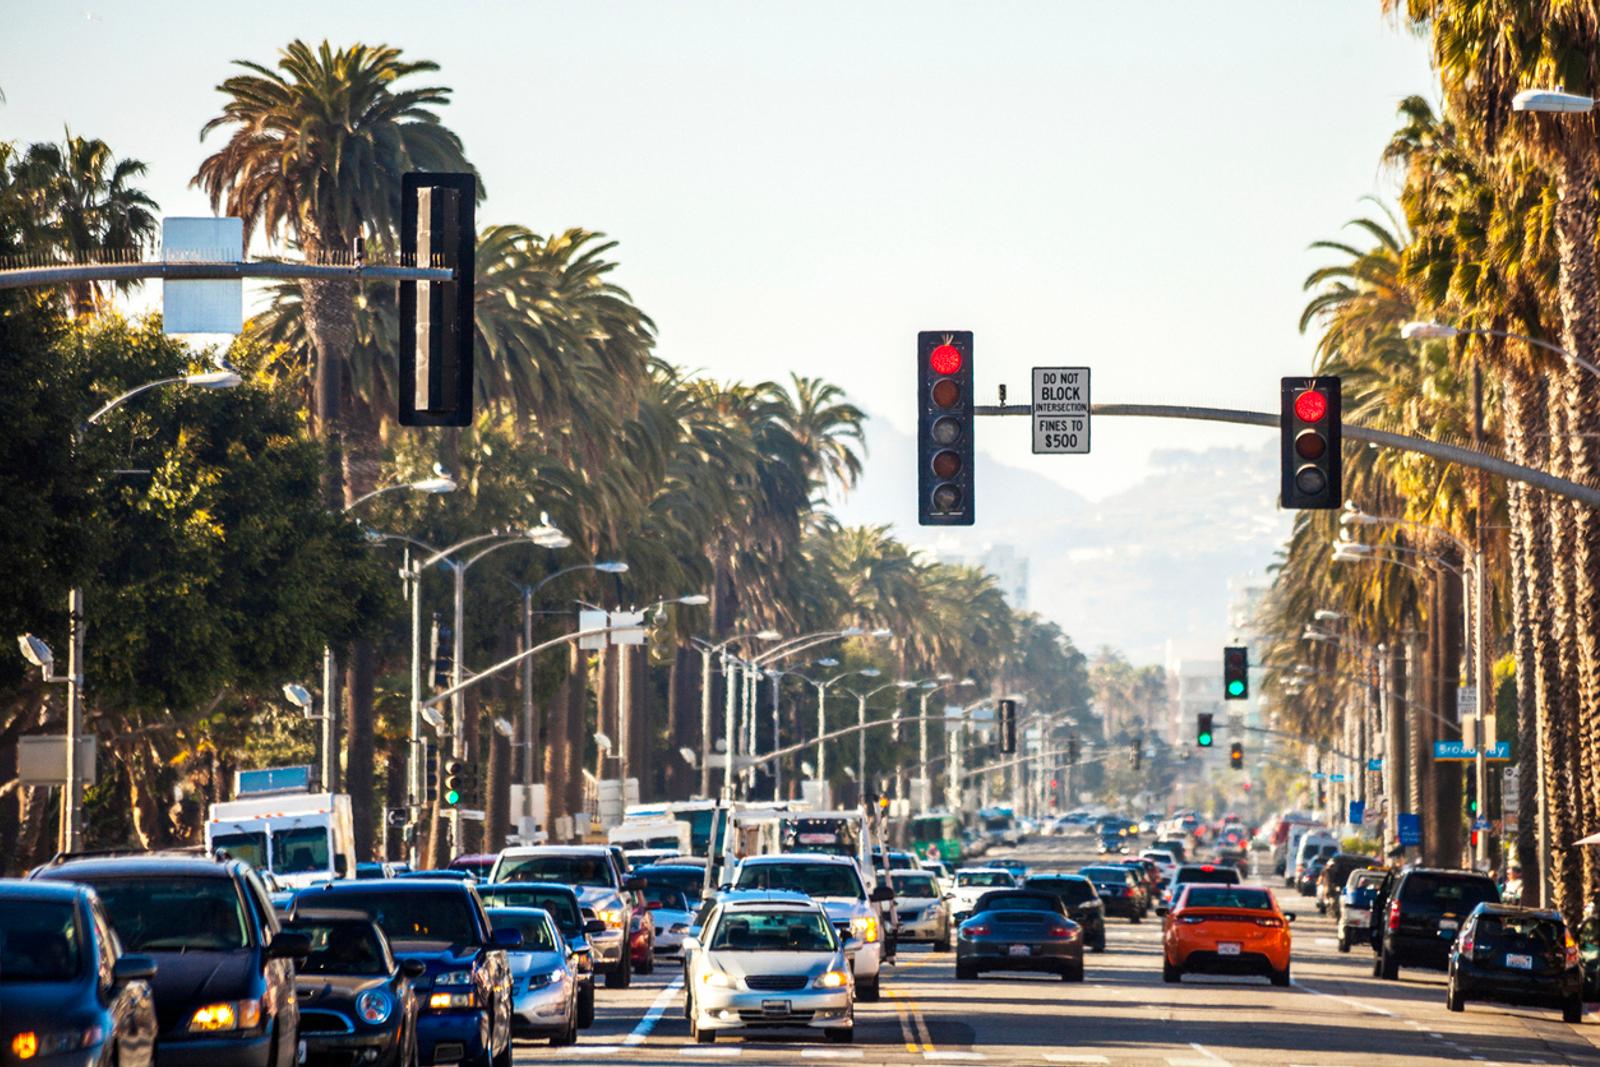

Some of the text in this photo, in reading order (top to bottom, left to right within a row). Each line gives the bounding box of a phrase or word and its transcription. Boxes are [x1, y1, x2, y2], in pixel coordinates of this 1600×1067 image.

[1043, 373, 1079, 384] DO NOT
[1041, 387, 1080, 401] BLOCK
[1035, 403, 1087, 412] INTERSECTION
[1039, 420, 1083, 432] FINES TO
[1045, 433, 1078, 448] $500
